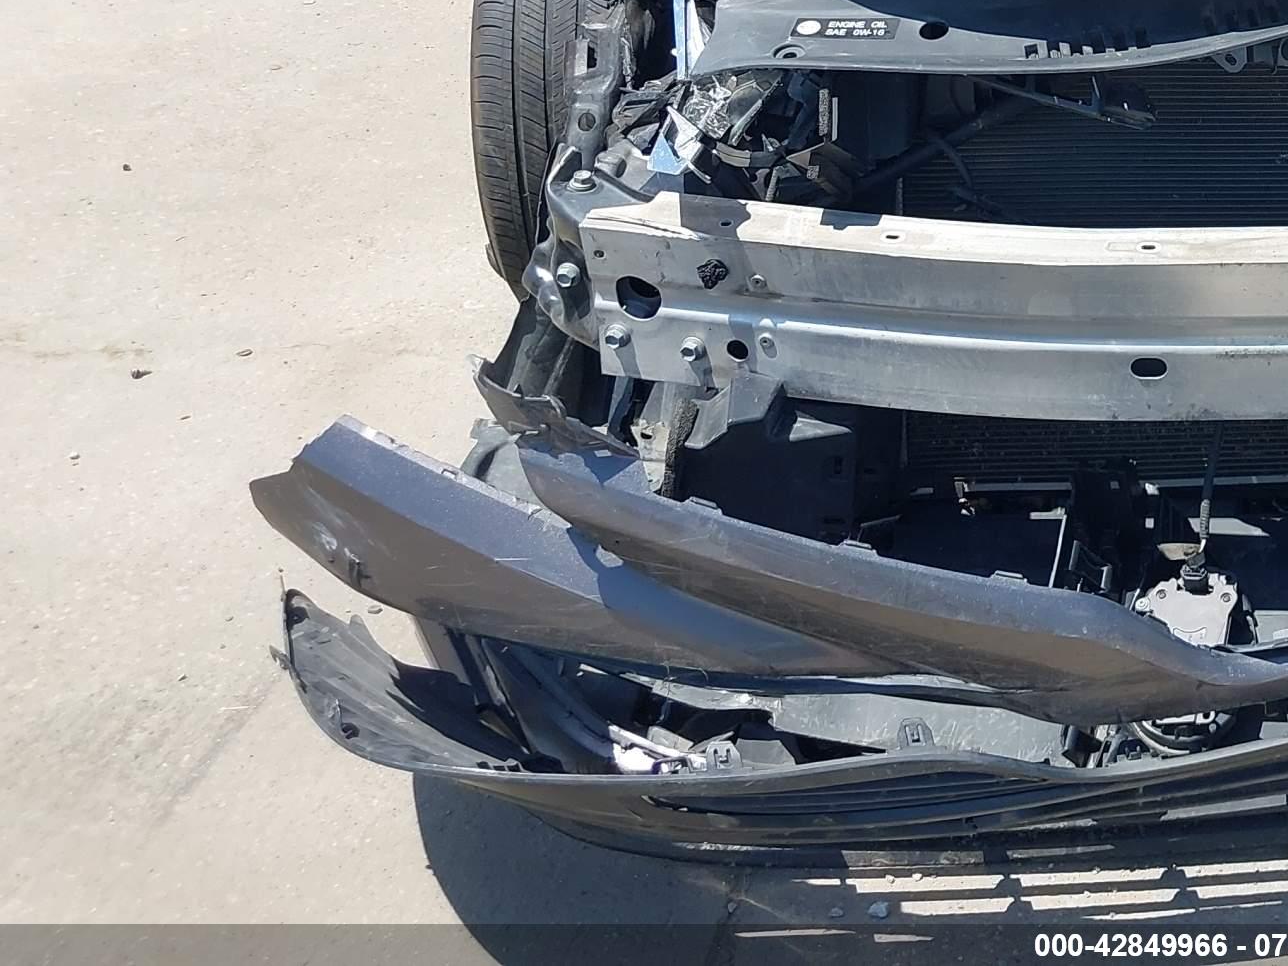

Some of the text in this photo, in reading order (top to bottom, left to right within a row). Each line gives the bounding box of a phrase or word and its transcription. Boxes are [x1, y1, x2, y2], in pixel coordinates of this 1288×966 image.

[828, 20, 888, 29] ENGINE OIL
[824, 28, 847, 36] SAE
